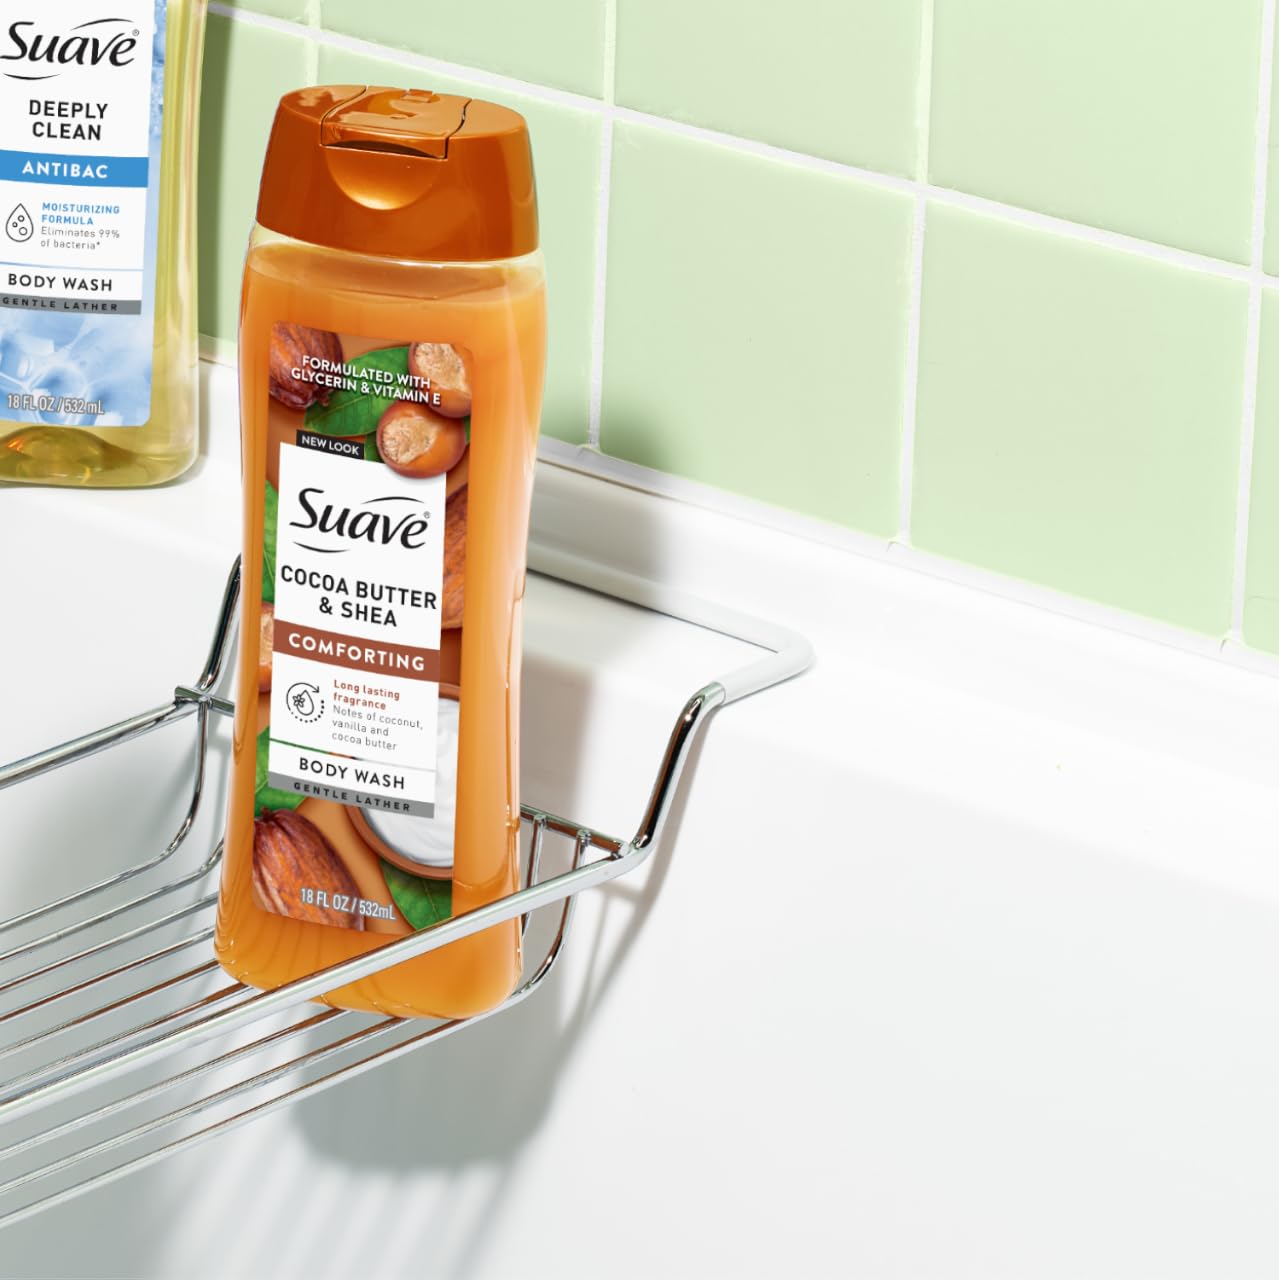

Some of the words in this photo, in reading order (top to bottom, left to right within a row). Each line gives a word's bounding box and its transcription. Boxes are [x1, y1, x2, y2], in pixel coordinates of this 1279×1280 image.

[0, 22, 136, 67] Suave
[29, 100, 107, 119] DEEPLY
[32, 122, 101, 140] CLEAN
[22, 161, 108, 178] ANTIBAC
[42, 202, 119, 214] MOISTURIZING
[42, 215, 93, 225] FORMULA
[41, 227, 95, 238] Eliminates
[99, 230, 120, 238] 99%
[41, 239, 51, 248] of
[8, 274, 55, 289] BODY
[63, 278, 112, 291] WASH
[2, 297, 56, 308] GENTLE
[64, 301, 118, 311] LATHER
[302, 355, 393, 383] FORMULATED
[397, 374, 430, 388] WITH
[292, 368, 357, 392] GLYCERIN
[361, 382, 370, 394] &
[373, 383, 429, 403] VITAMIN
[433, 393, 440, 404] E
[302, 436, 326, 448] NEW
[329, 441, 359, 456] LOOK
[289, 488, 428, 549] Suave
[281, 565, 348, 595] COCOA
[356, 581, 436, 609] BUTTER
[320, 597, 333, 615] &
[341, 601, 397, 626] SHEA
[288, 633, 425, 670] COMFORTING
[300, 757, 348, 779] BODY
[355, 772, 405, 790] WASH
[294, 782, 348, 800] GENTLE
[356, 795, 411, 812] LATHER
